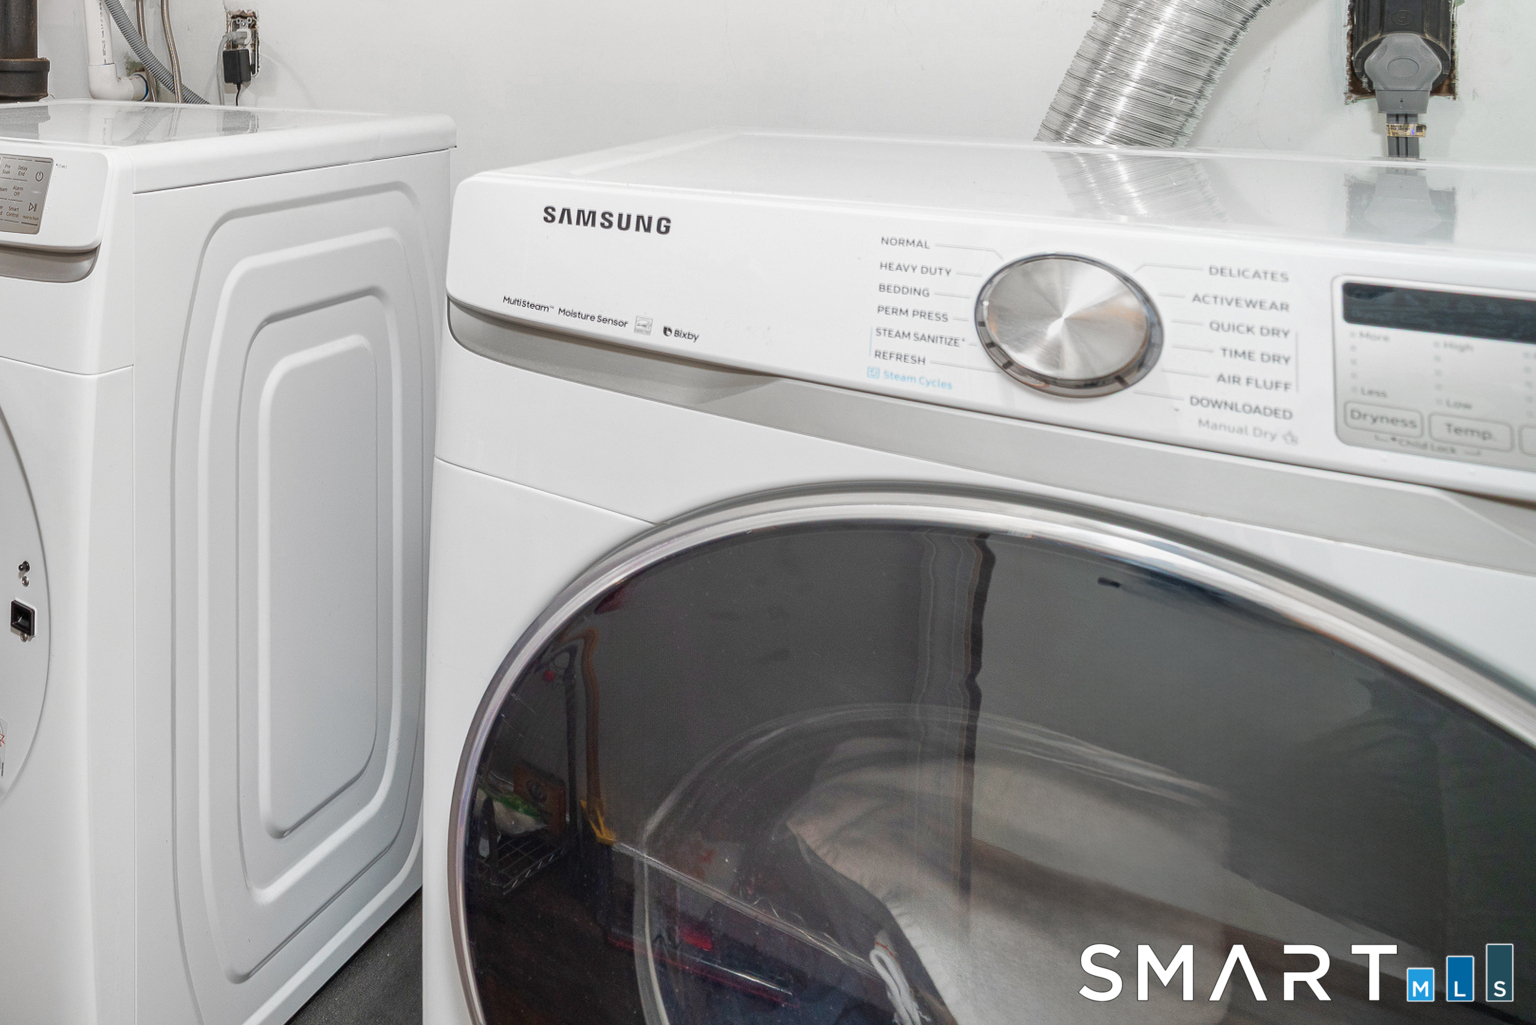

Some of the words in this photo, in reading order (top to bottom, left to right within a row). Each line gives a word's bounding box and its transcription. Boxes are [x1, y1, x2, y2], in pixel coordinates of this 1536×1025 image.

[543, 206, 672, 235] SAMSUNG
[881, 236, 930, 249] NORMAL
[880, 261, 917, 273] HEAVY
[920, 265, 952, 277] DUTY
[1208, 266, 1290, 283] DELICATES
[879, 283, 930, 297] BEDDING
[1192, 292, 1290, 312] ACTIVEWEAR
[877, 305, 909, 317] PERM
[912, 310, 948, 322] PRESS
[558, 307, 596, 322] Moisture
[596, 315, 629, 328] Sensor
[674, 328, 699, 343] Bixby
[876, 327, 911, 339] STEAM
[1209, 320, 1256, 335] QUICK
[1260, 326, 1290, 339] DRY
[1359, 330, 1390, 343] More
[1443, 341, 1474, 353] High
[874, 350, 926, 365] REFRESH
[1220, 348, 1256, 361] TIME
[1260, 352, 1291, 366] DRY
[883, 371, 917, 383] Steam
[918, 376, 953, 390] Cycles
[1216, 373, 1241, 386] AIR
[1246, 377, 1292, 392] FLUFF
[1360, 386, 1387, 398] Less
[1189, 395, 1293, 420] DOWNLOADED
[1446, 399, 1472, 411] Low
[1350, 409, 1417, 429] Dryness
[1198, 418, 1248, 436] Manual
[1252, 425, 1277, 442] Dry
[1430, 440, 1458, 454] Lock
